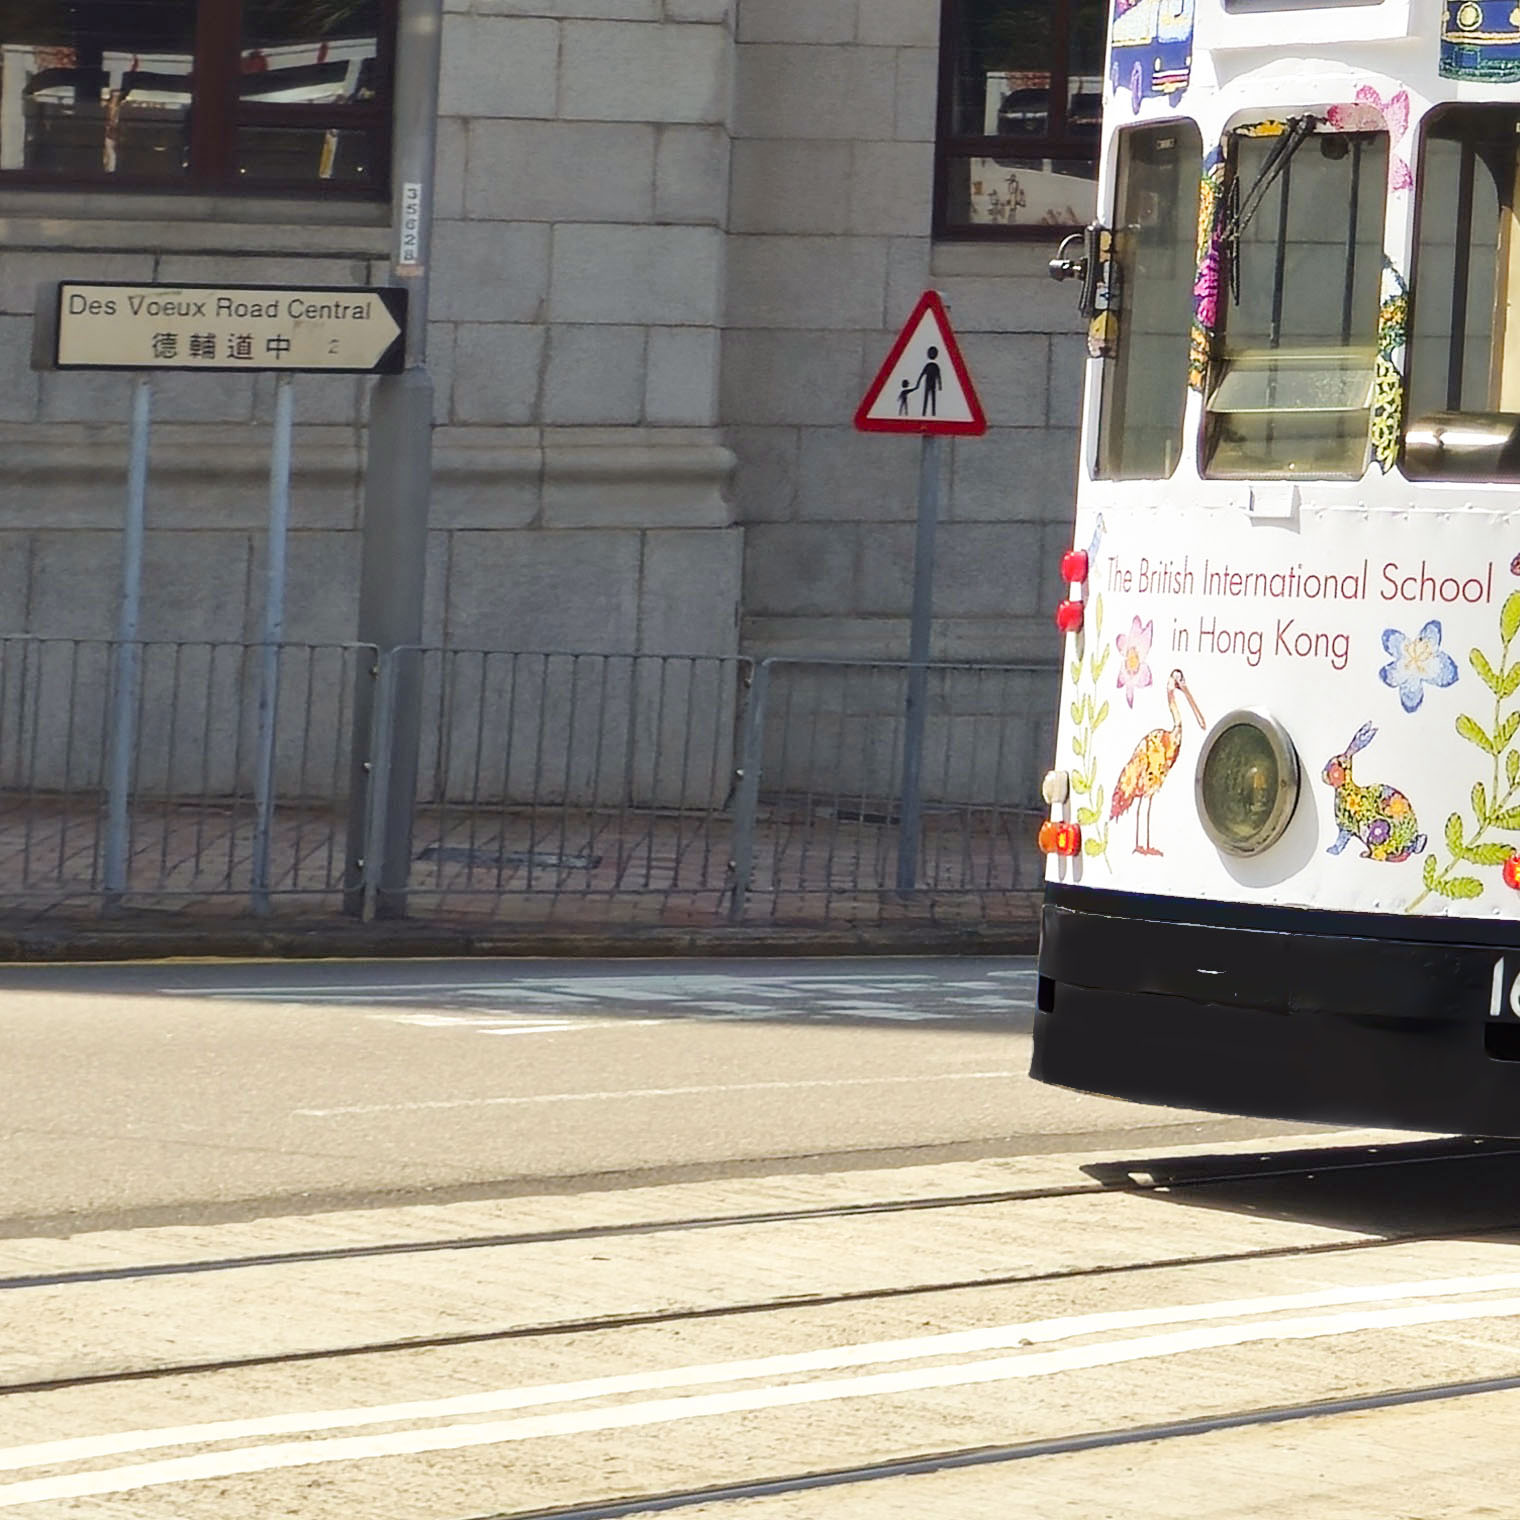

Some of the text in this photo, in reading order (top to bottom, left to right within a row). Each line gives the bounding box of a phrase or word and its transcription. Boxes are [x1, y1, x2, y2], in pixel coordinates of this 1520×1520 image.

[68, 294, 371, 321] Des Voeux Road Central
[152, 333, 291, 360] 德輔道中
[1107, 555, 1493, 603] The British International School
[1171, 616, 1350, 670] in Hong Kong
